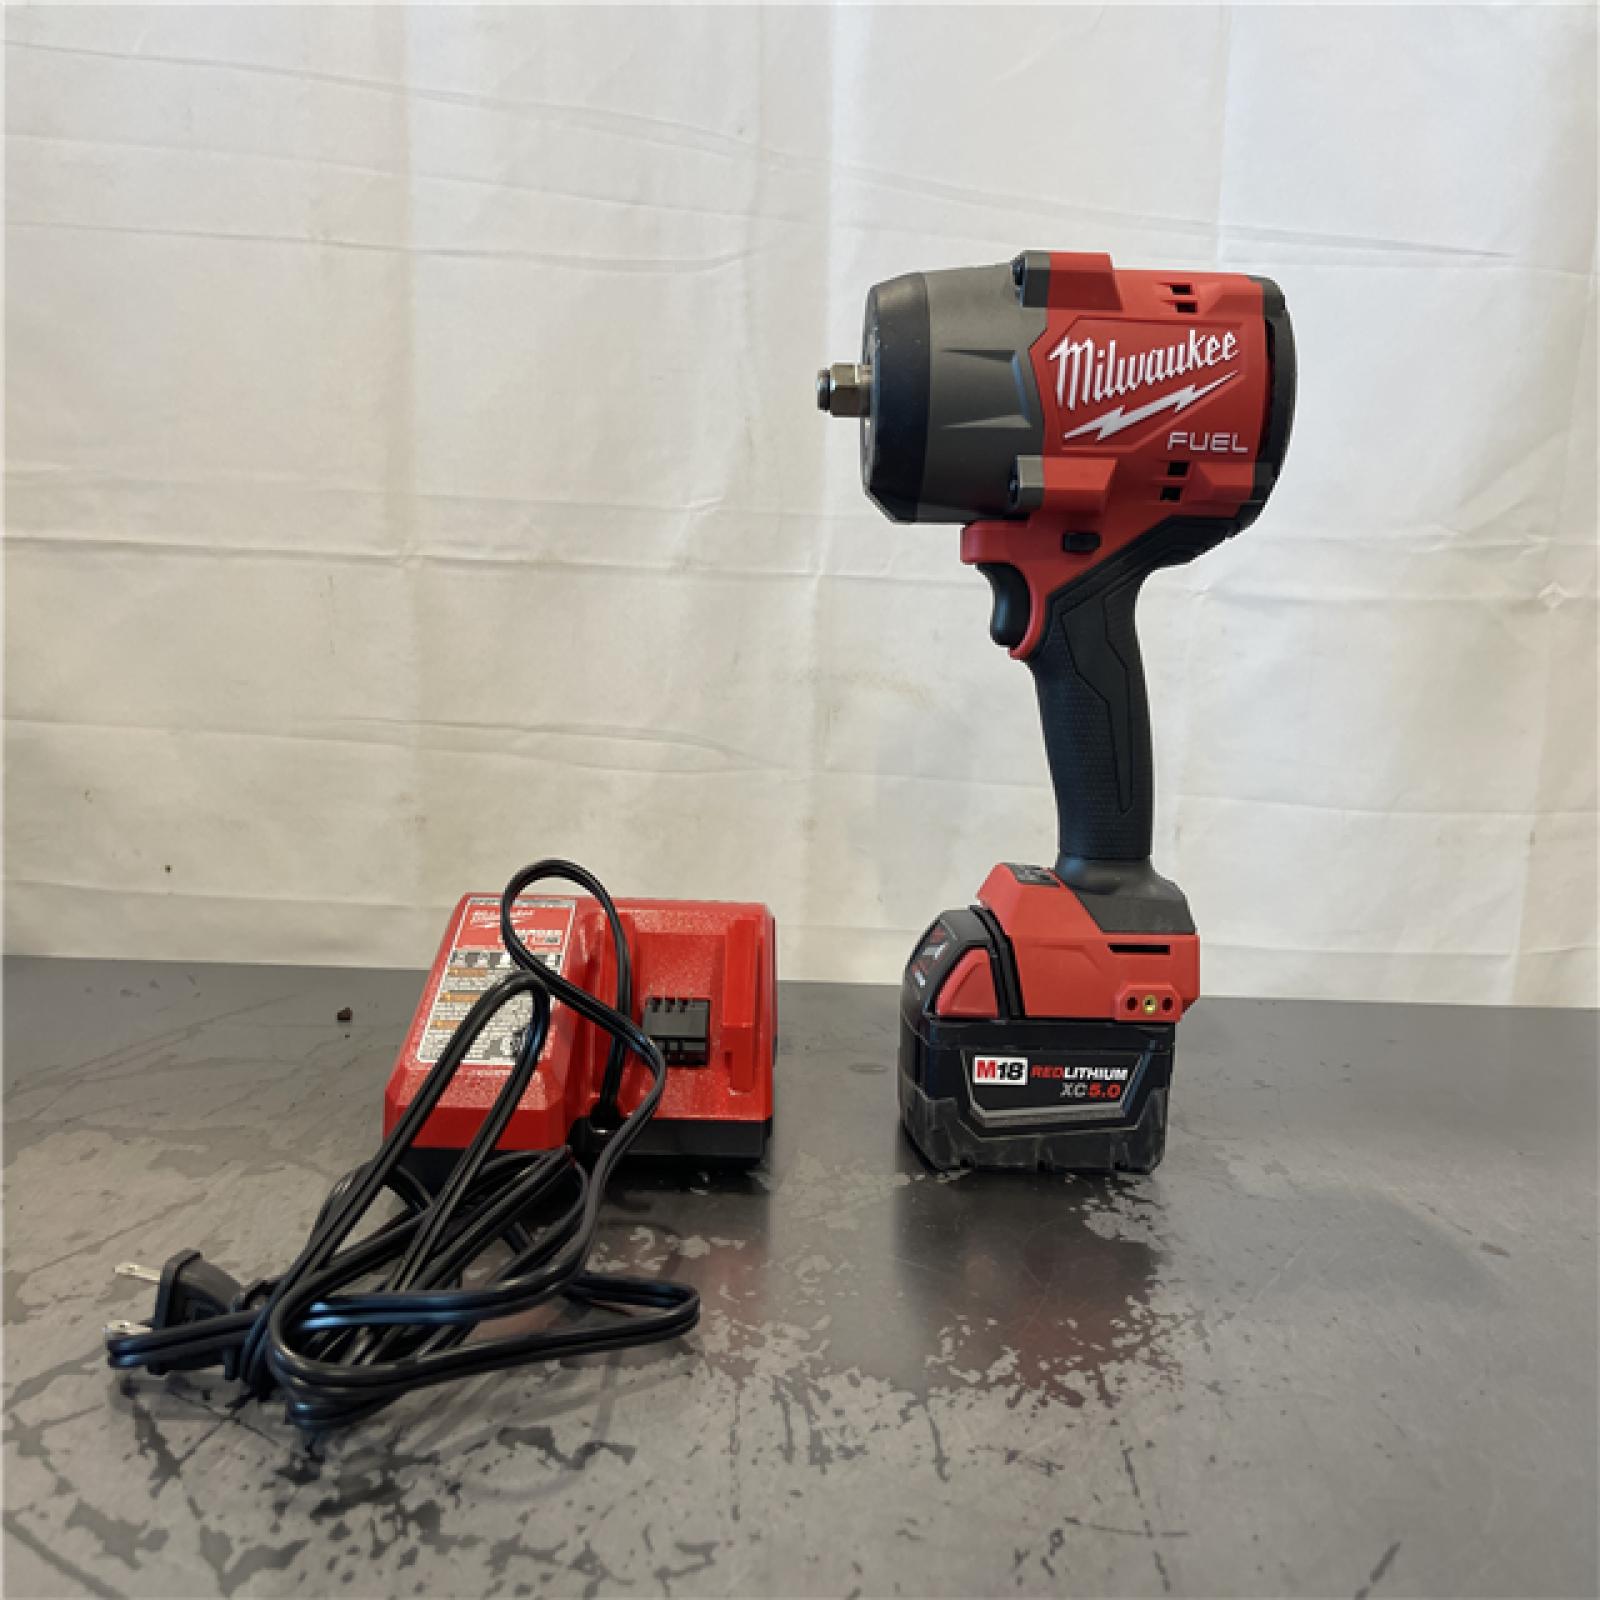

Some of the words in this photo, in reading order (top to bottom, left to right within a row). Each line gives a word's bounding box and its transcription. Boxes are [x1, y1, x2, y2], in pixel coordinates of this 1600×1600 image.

[1048, 329, 1240, 411] Milwaukee
[1167, 431, 1249, 453] FUEL
[976, 1059, 1024, 1081] M18
[1031, 1064, 1129, 1081] REDLITHIUM
